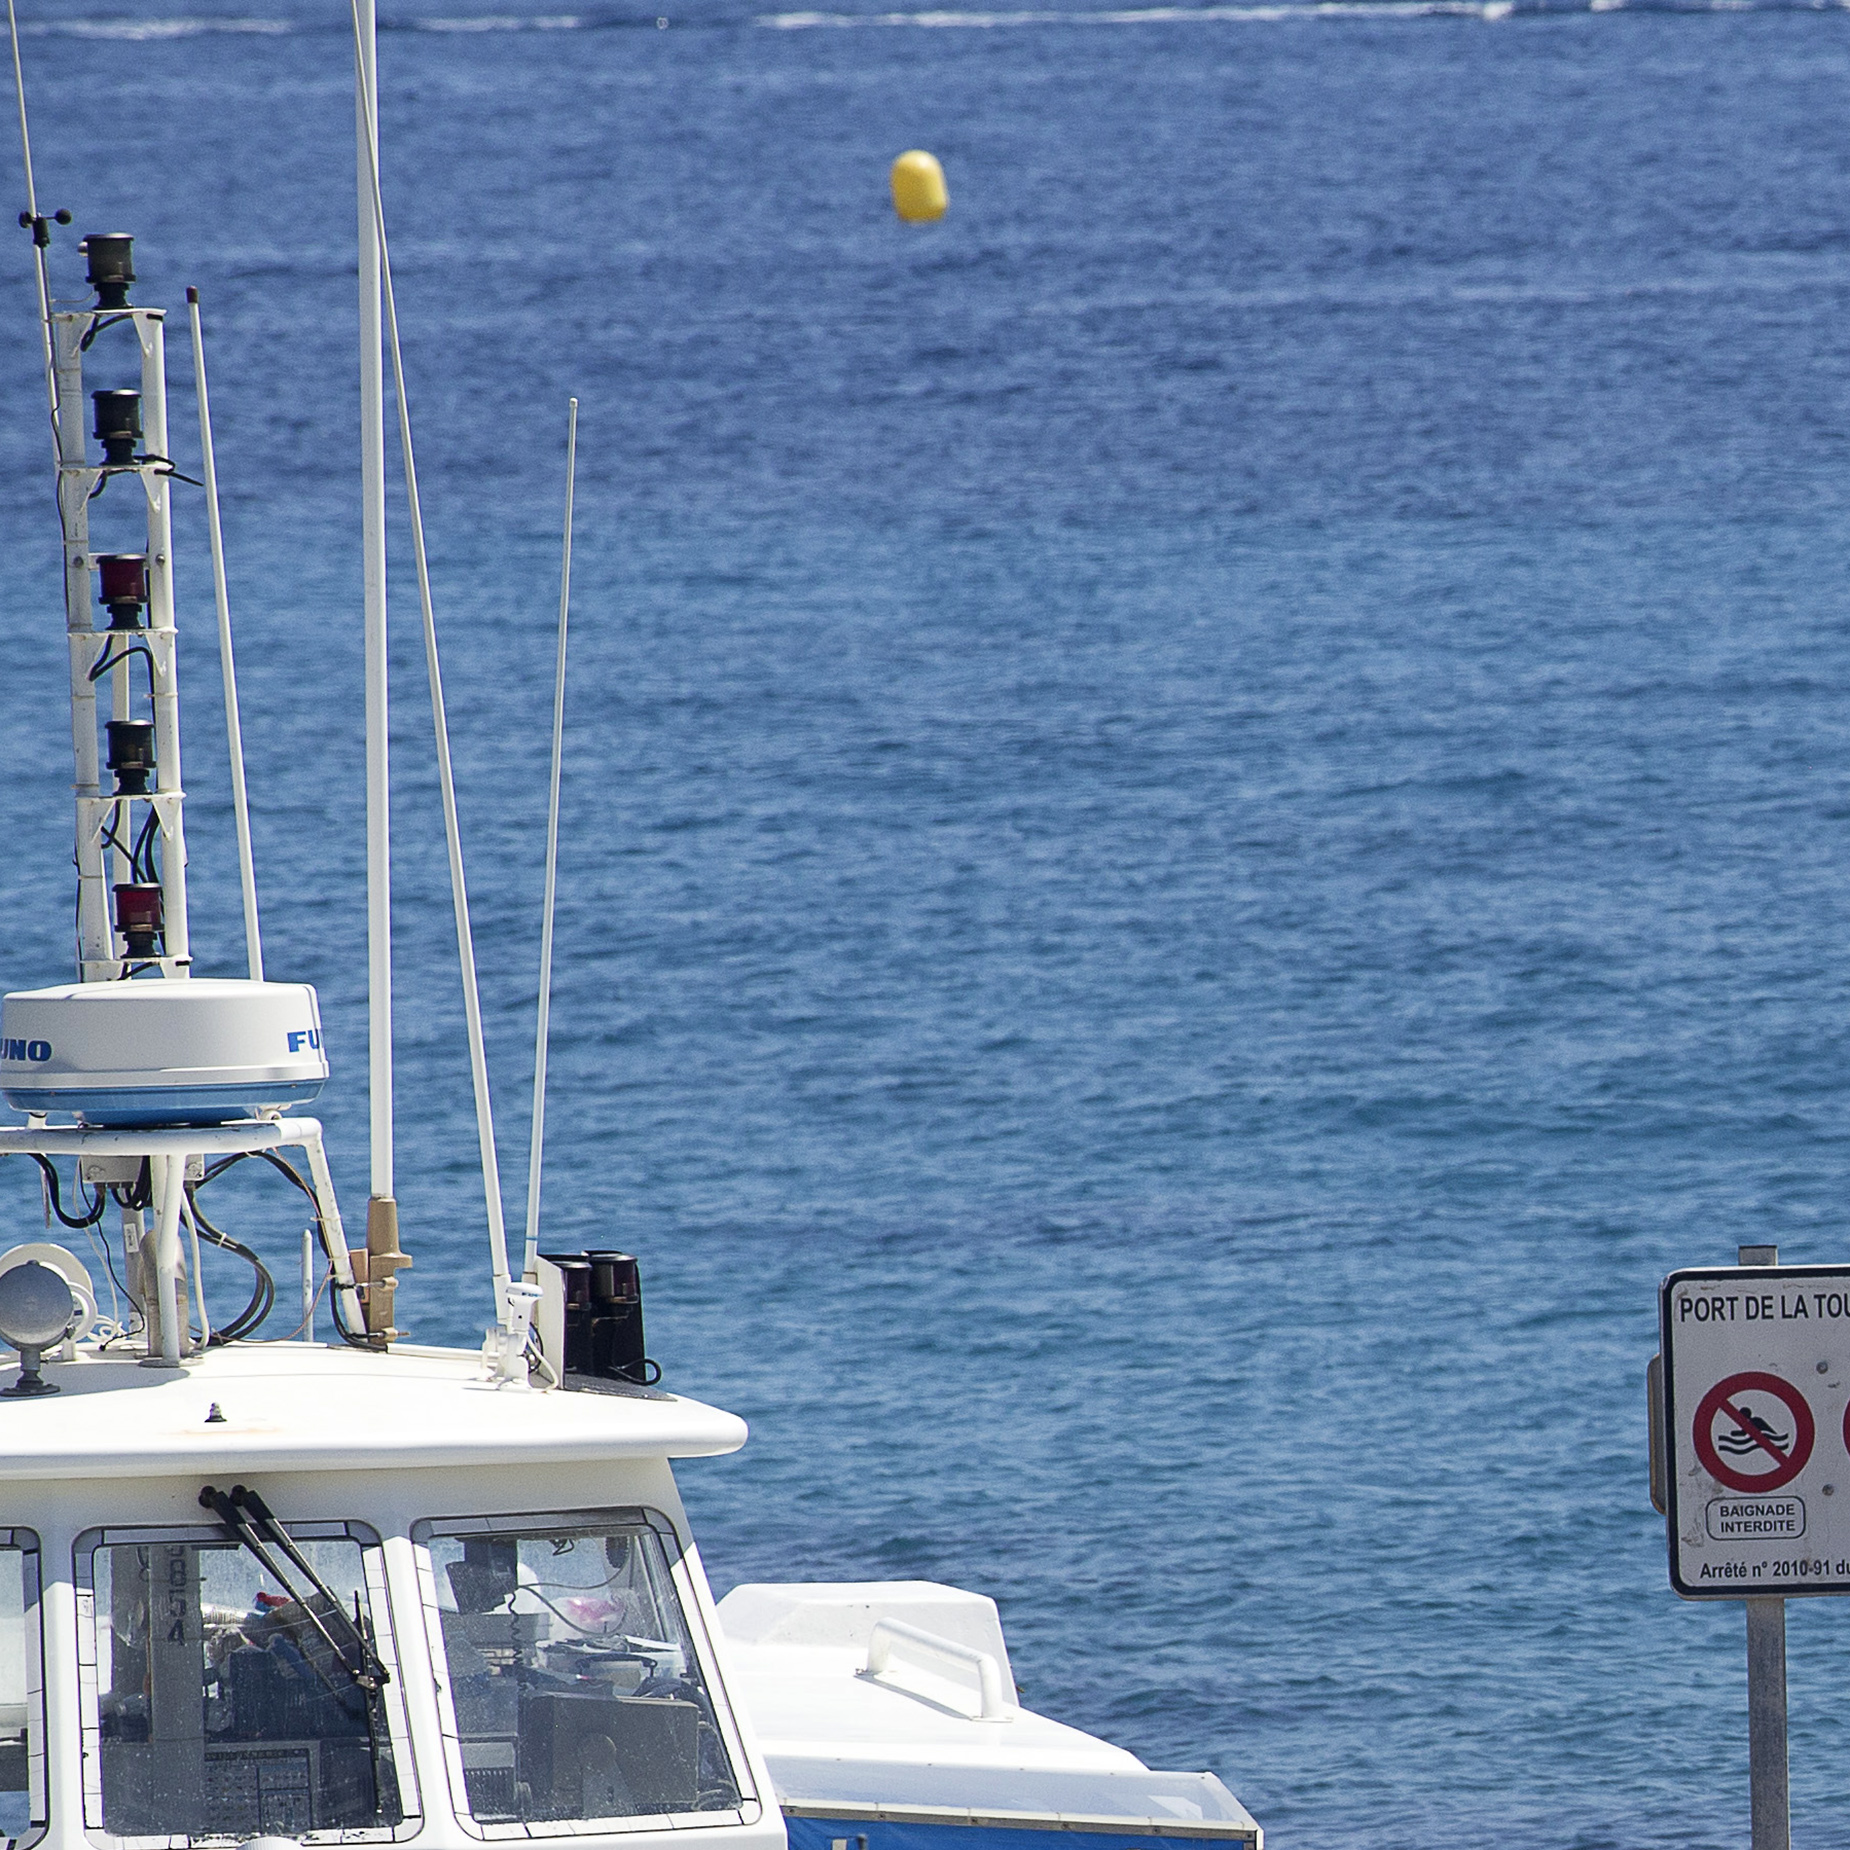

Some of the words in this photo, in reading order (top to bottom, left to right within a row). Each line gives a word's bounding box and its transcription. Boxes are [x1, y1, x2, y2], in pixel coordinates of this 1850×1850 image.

[1680, 1297, 1738, 1322] PORT
[1745, 1295, 1774, 1320] DE
[1781, 1294, 1809, 1319] LA
[1719, 1502, 1796, 1518] BAIGNADE
[1720, 1519, 1796, 1533] INTERDITE
[1700, 1560, 1747, 1580] Arrêté
[1751, 1561, 1769, 1577] n°
[1772, 1559, 1831, 1577] 2010-91
